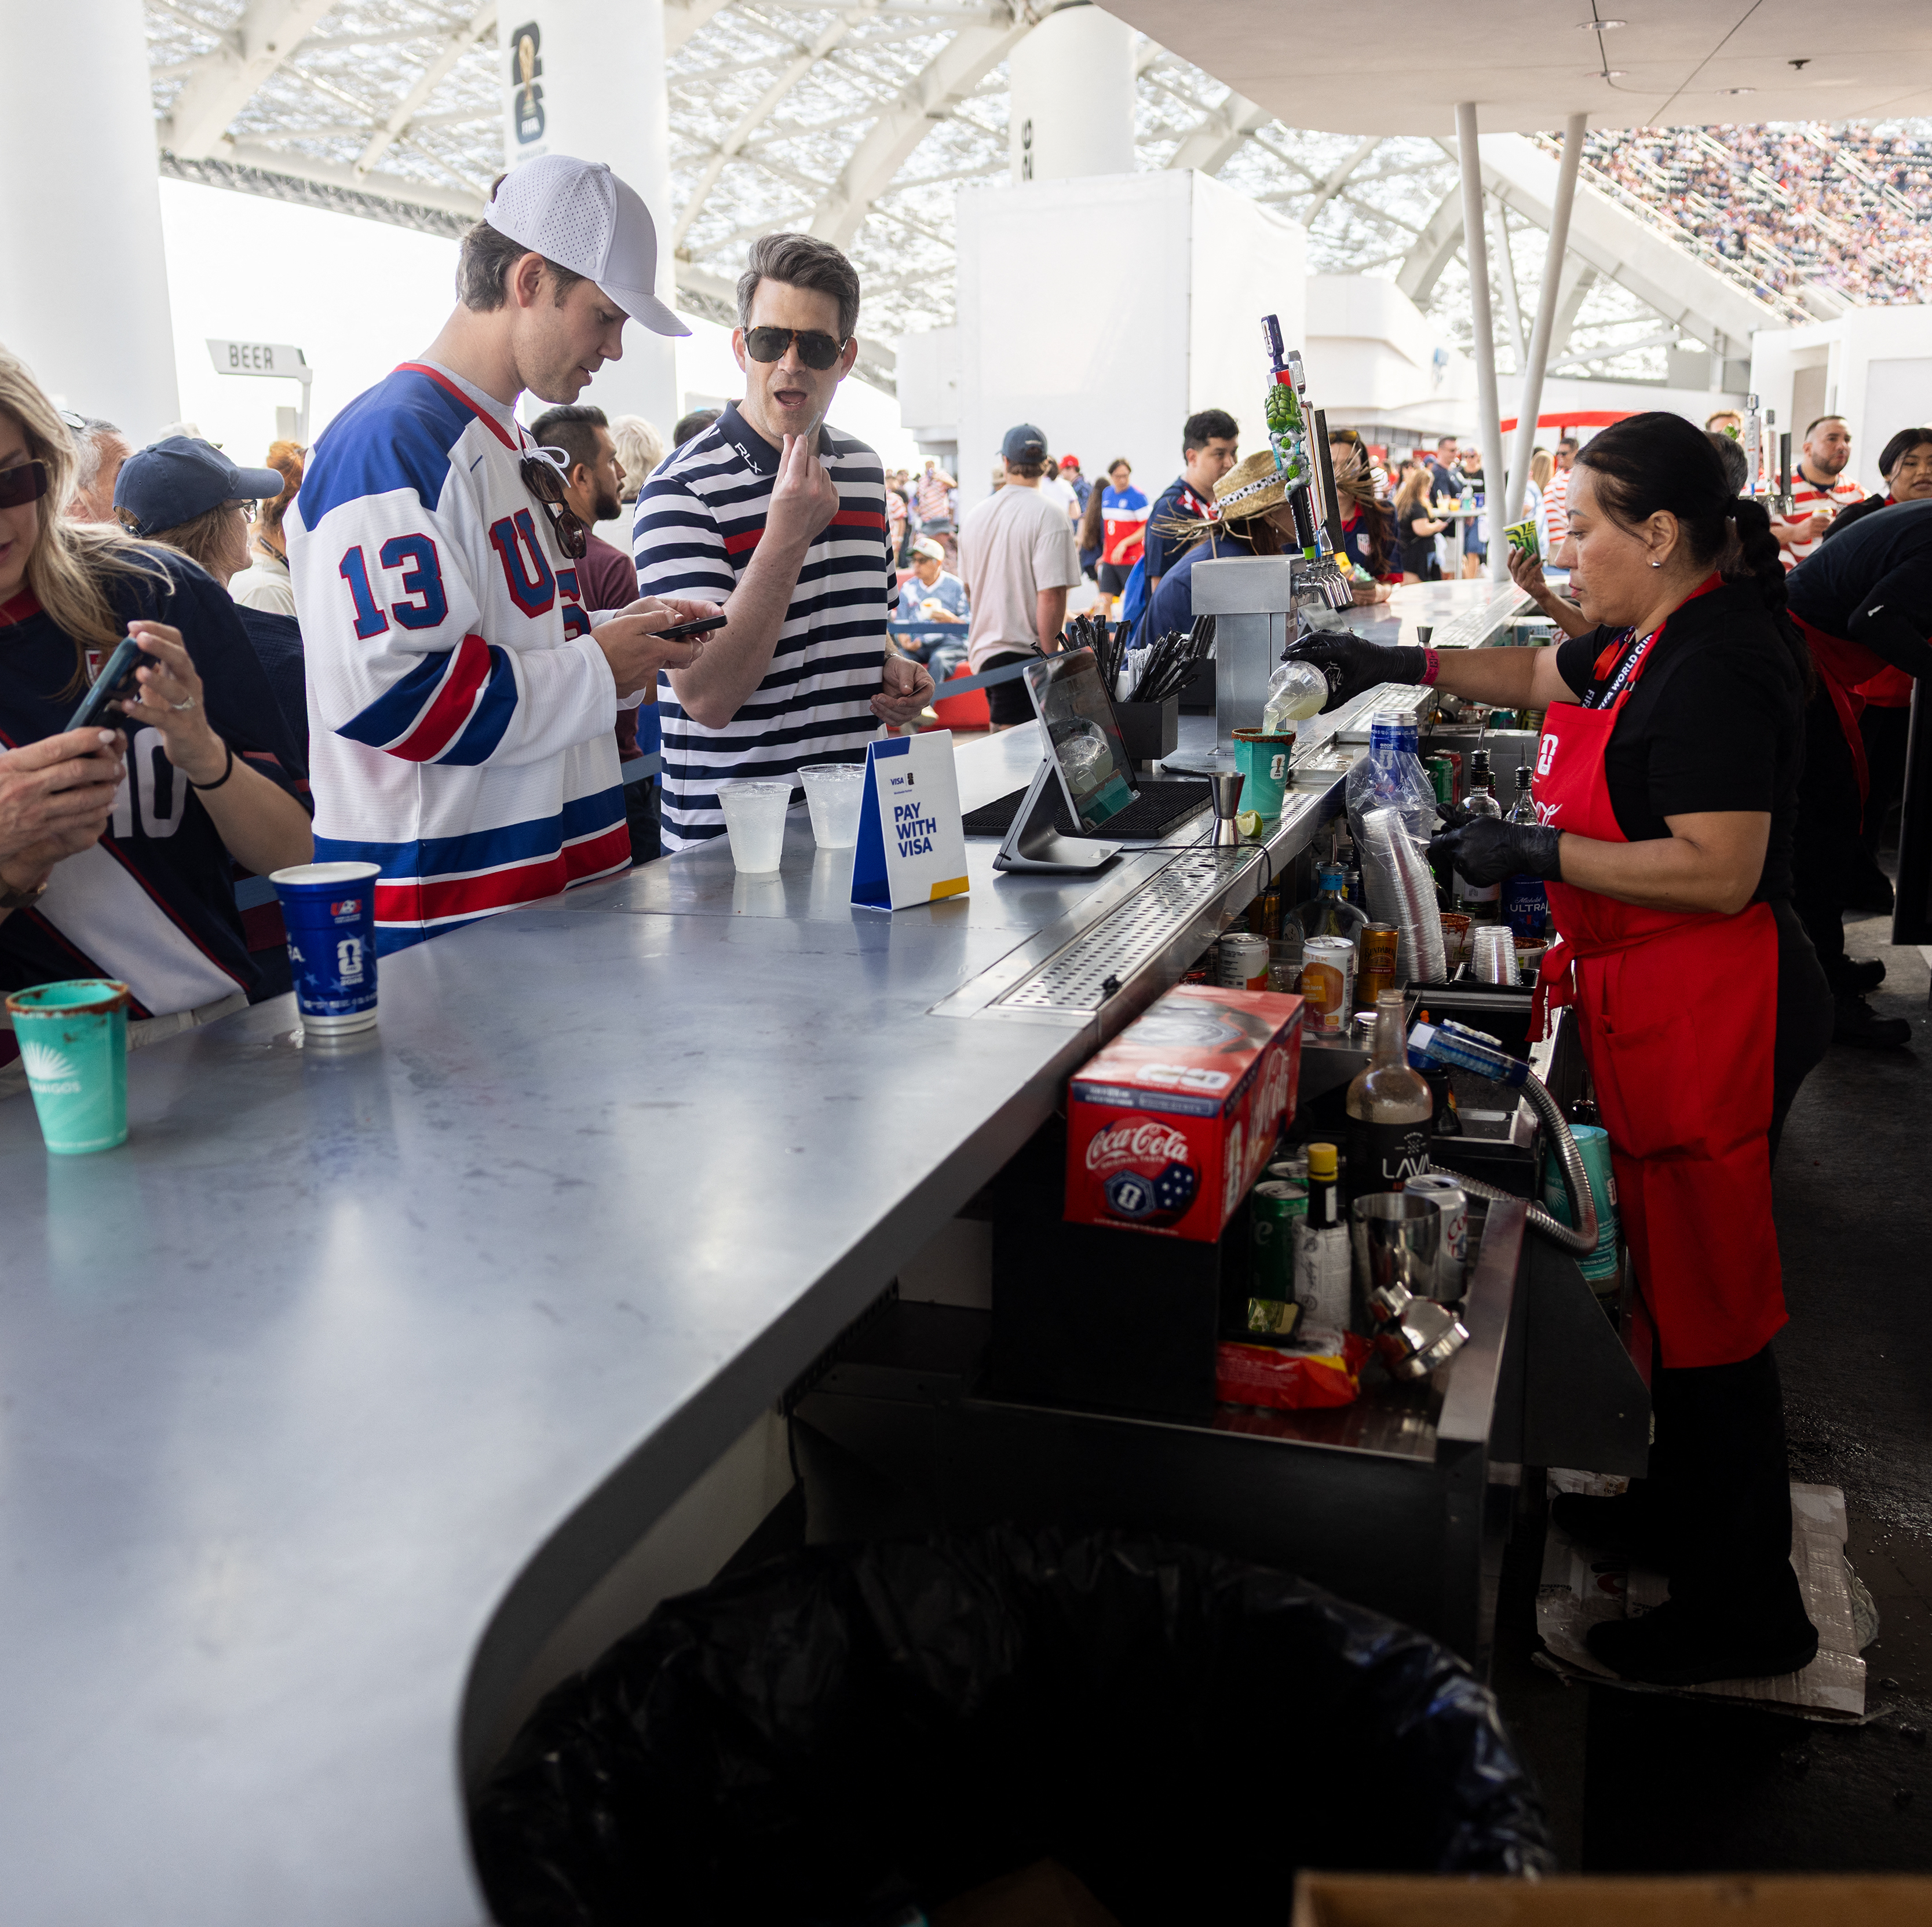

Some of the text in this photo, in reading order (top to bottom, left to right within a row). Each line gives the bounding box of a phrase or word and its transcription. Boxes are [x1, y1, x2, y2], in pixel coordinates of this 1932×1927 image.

[229, 345, 273, 370] BEER
[734, 442, 763, 474] RLX
[339, 532, 449, 641] 13
[1611, 654, 1638, 690] WORLD
[890, 777, 904, 785] VISA
[894, 802, 921, 822] PAY
[896, 817, 937, 840] WITH
[898, 836, 933, 858] VISA
[1510, 902, 1546, 912] ULTRA
[1085, 1122, 1189, 1171] Coca-Cola
[1539, 1584, 1572, 1592] Bottles
[1632, 1601, 1655, 1611] ttles
